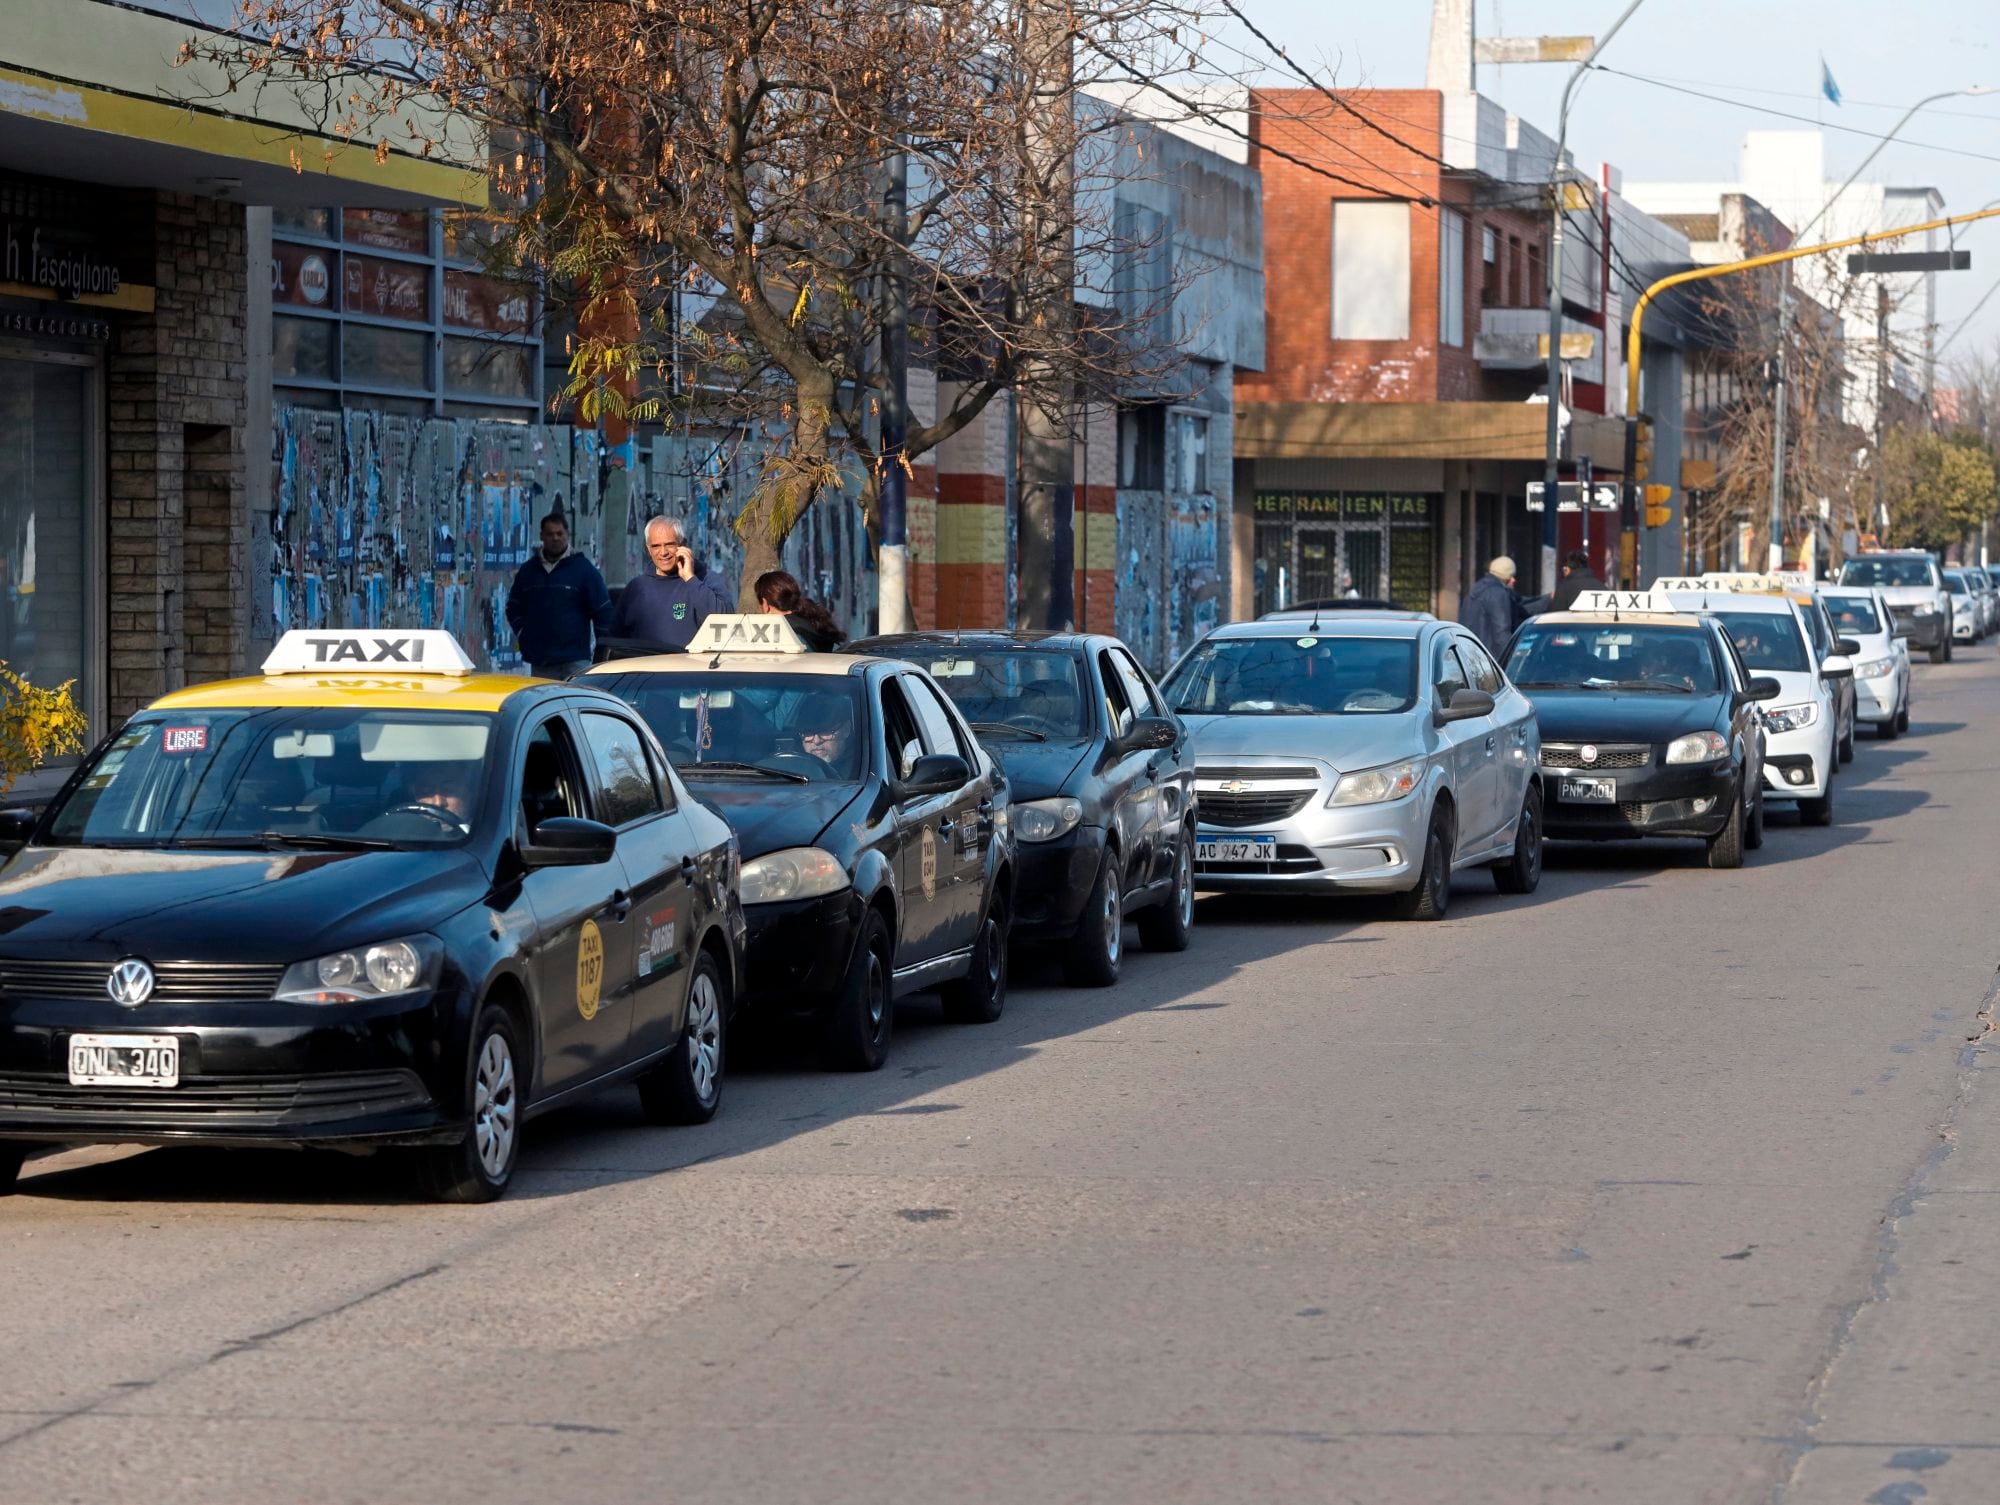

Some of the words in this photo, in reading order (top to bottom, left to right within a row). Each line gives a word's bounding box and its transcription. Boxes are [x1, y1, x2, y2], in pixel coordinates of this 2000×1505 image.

[1660, 580, 1720, 589] TAXI
[1591, 593, 1652, 608] TAXI
[710, 624, 781, 643] TAXI
[305, 638, 425, 662] TAXI
[167, 730, 203, 750] LIBRE
[1200, 844, 1216, 858] AC
[1254, 844, 1271, 858] JK
[582, 934, 599, 956] TAXI
[581, 955, 601, 988] 1187
[130, 1048, 174, 1077] 340
